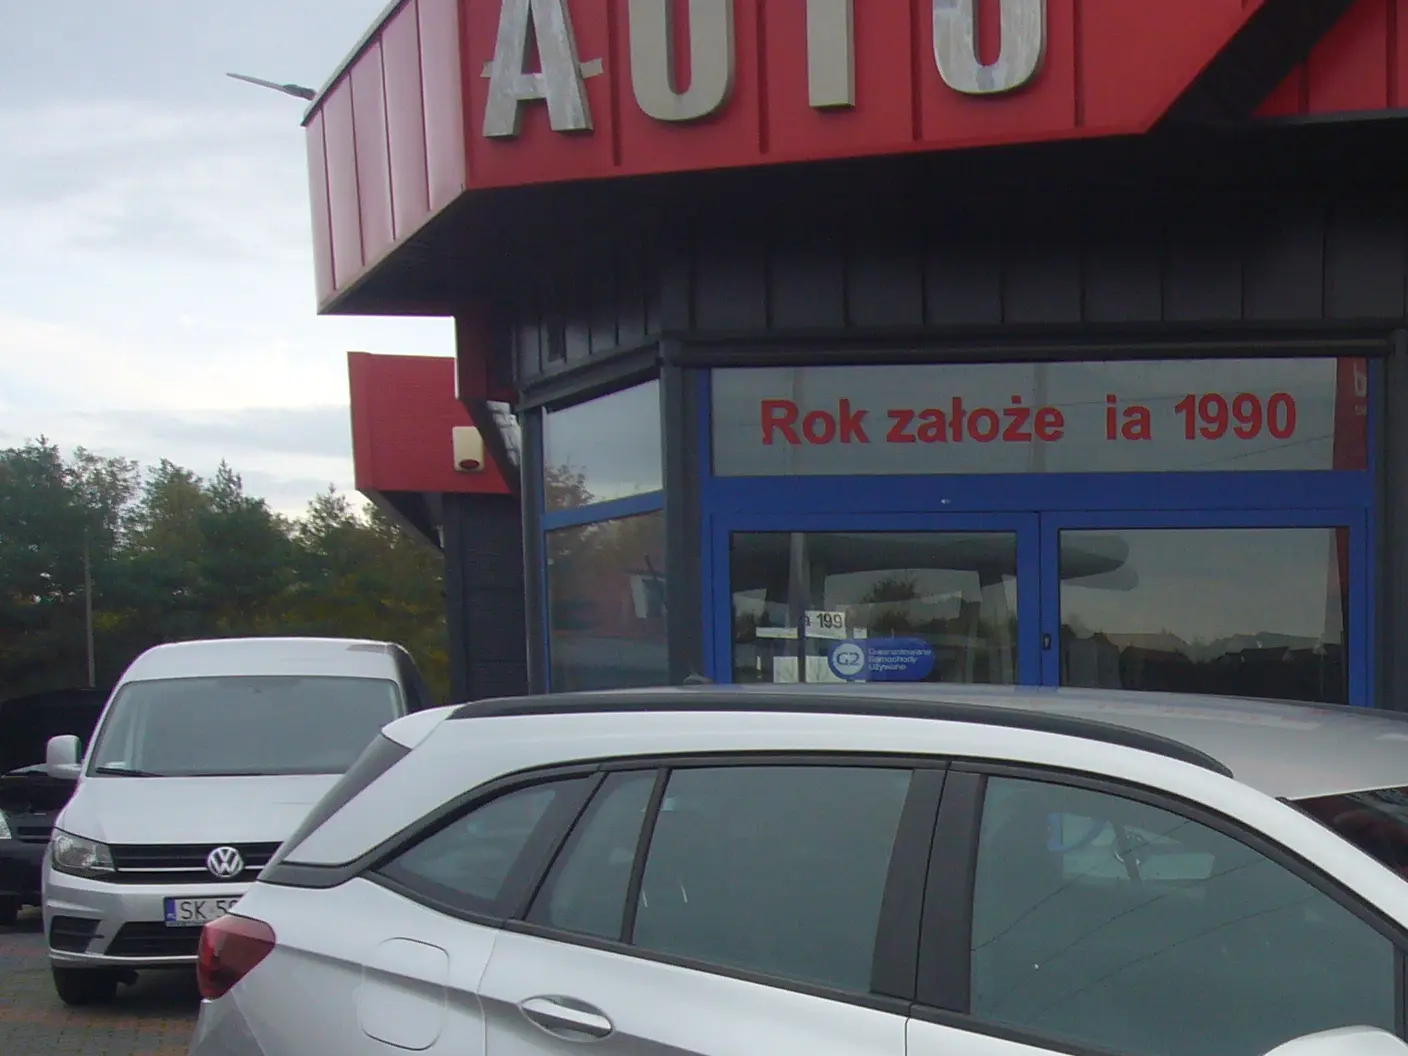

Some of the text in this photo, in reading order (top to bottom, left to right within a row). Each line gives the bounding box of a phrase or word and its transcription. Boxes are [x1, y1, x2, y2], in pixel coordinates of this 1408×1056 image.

[760, 398, 871, 445] Rok
[1173, 392, 1297, 441] 1990
[180, 900, 207, 920] SK
